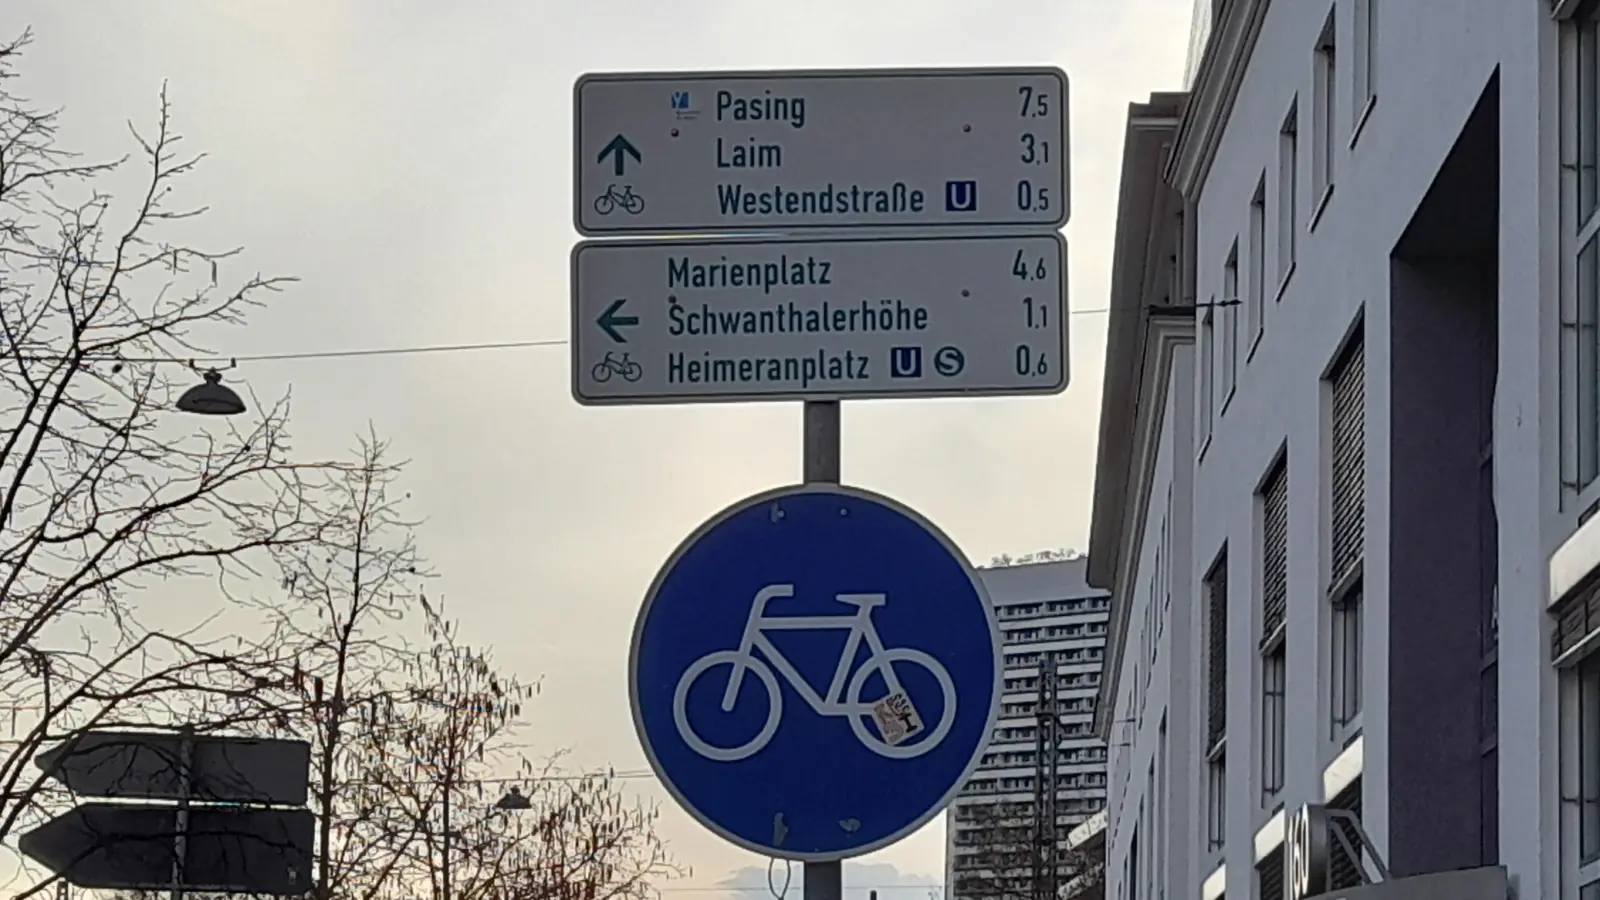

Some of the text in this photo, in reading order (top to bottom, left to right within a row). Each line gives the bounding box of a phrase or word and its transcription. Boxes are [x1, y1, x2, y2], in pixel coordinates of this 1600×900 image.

[716, 90, 805, 128] Pasing
[716, 137, 781, 168] Laim
[717, 181, 924, 215] Westendstraße
[948, 182, 974, 210] U
[668, 254, 832, 294] Marienplatz
[668, 300, 928, 336] Schwanthalerhöhe
[668, 348, 870, 388] Heimeranplatz
[893, 347, 920, 377] U
[936, 347, 963, 376] S
[1288, 801, 1309, 900] 160
